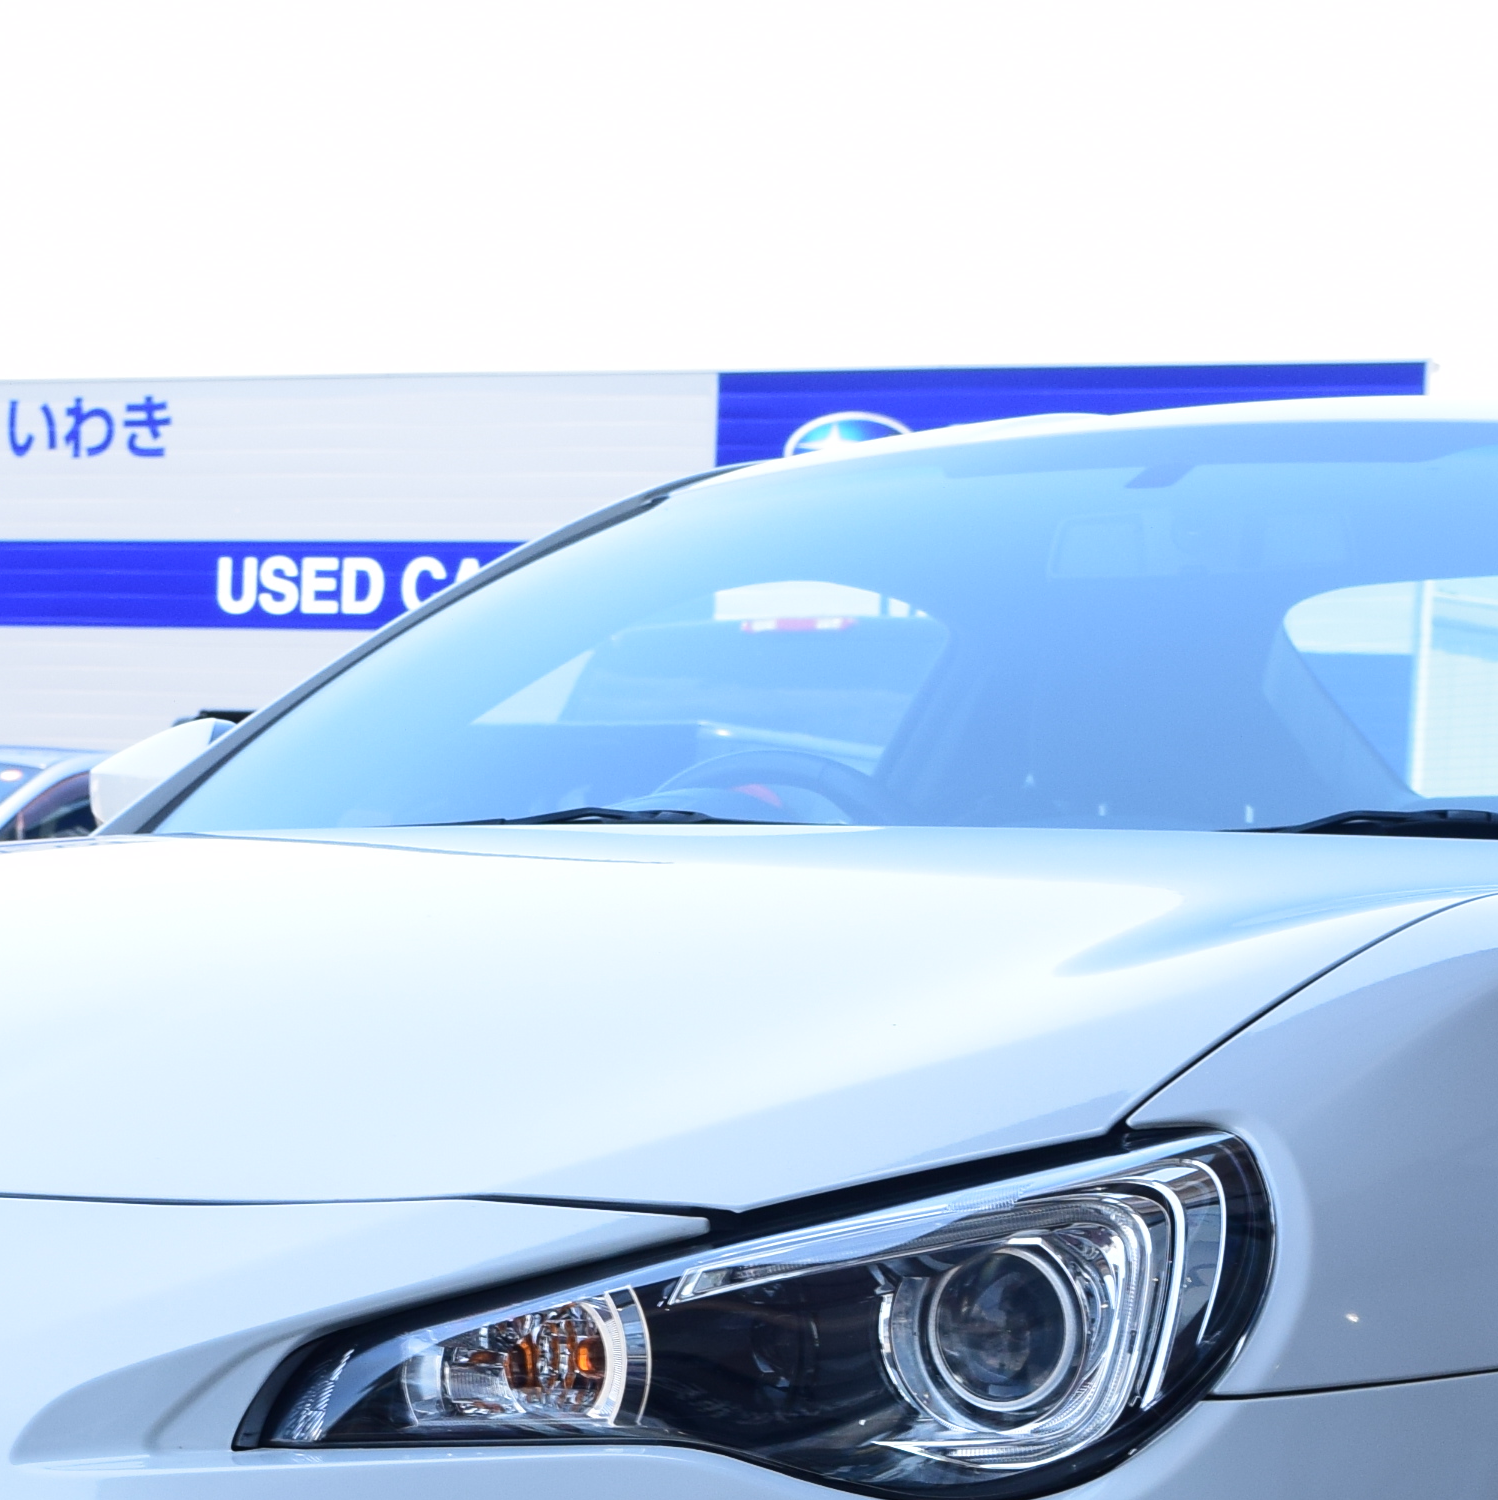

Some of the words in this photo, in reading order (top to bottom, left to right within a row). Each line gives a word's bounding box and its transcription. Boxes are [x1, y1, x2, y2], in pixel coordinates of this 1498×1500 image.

[7, 394, 172, 458] いわき
[217, 556, 385, 615] USED
